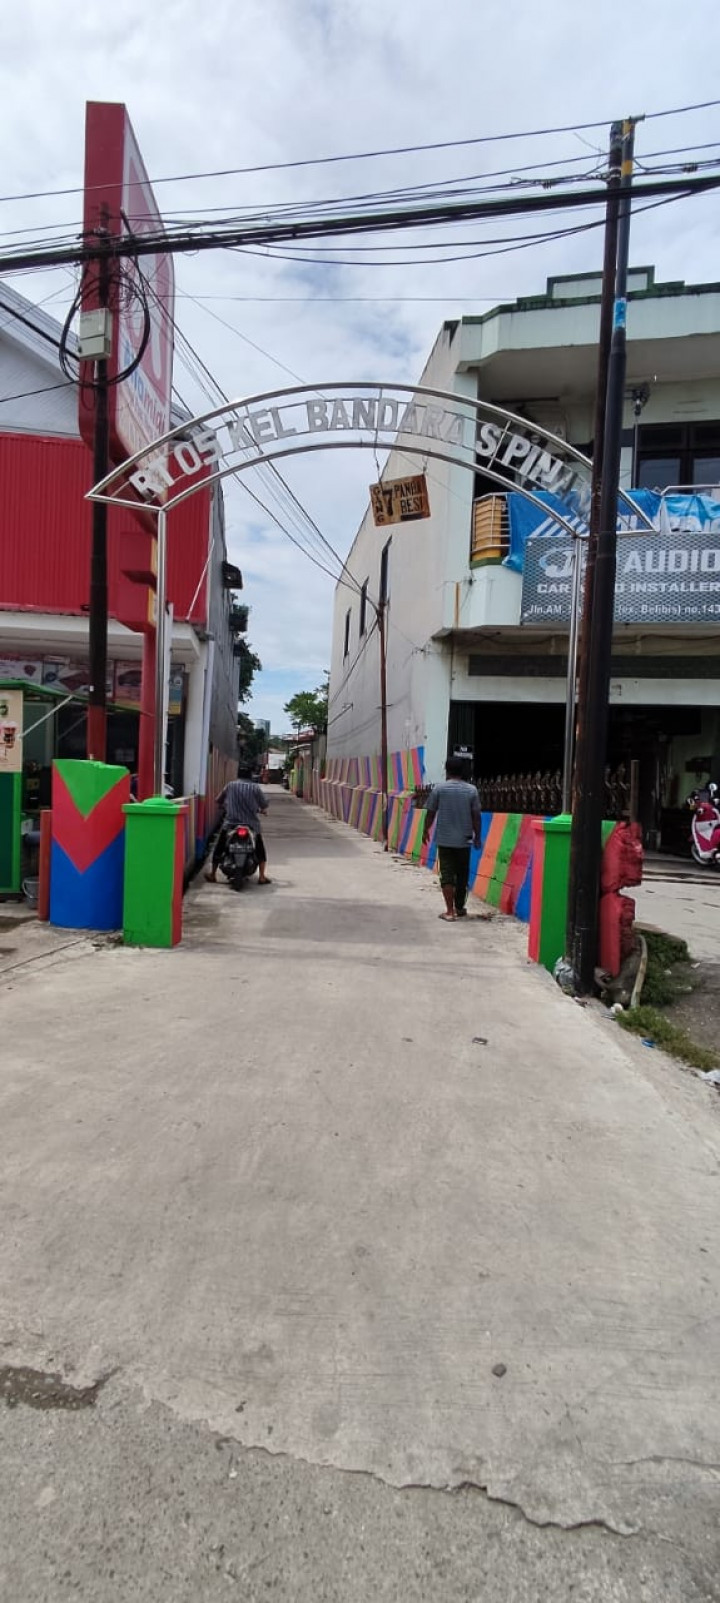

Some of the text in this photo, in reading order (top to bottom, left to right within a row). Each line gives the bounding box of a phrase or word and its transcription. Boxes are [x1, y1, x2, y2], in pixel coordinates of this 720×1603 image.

[173, 428, 224, 475] 05
[227, 406, 297, 450] KEL
[307, 398, 465, 446] BANDARA
[382, 489, 393, 517] 7
[623, 550, 720, 572] AUDIO
[537, 584, 571, 593] CAR
[630, 581, 720, 592] INSTALLER
